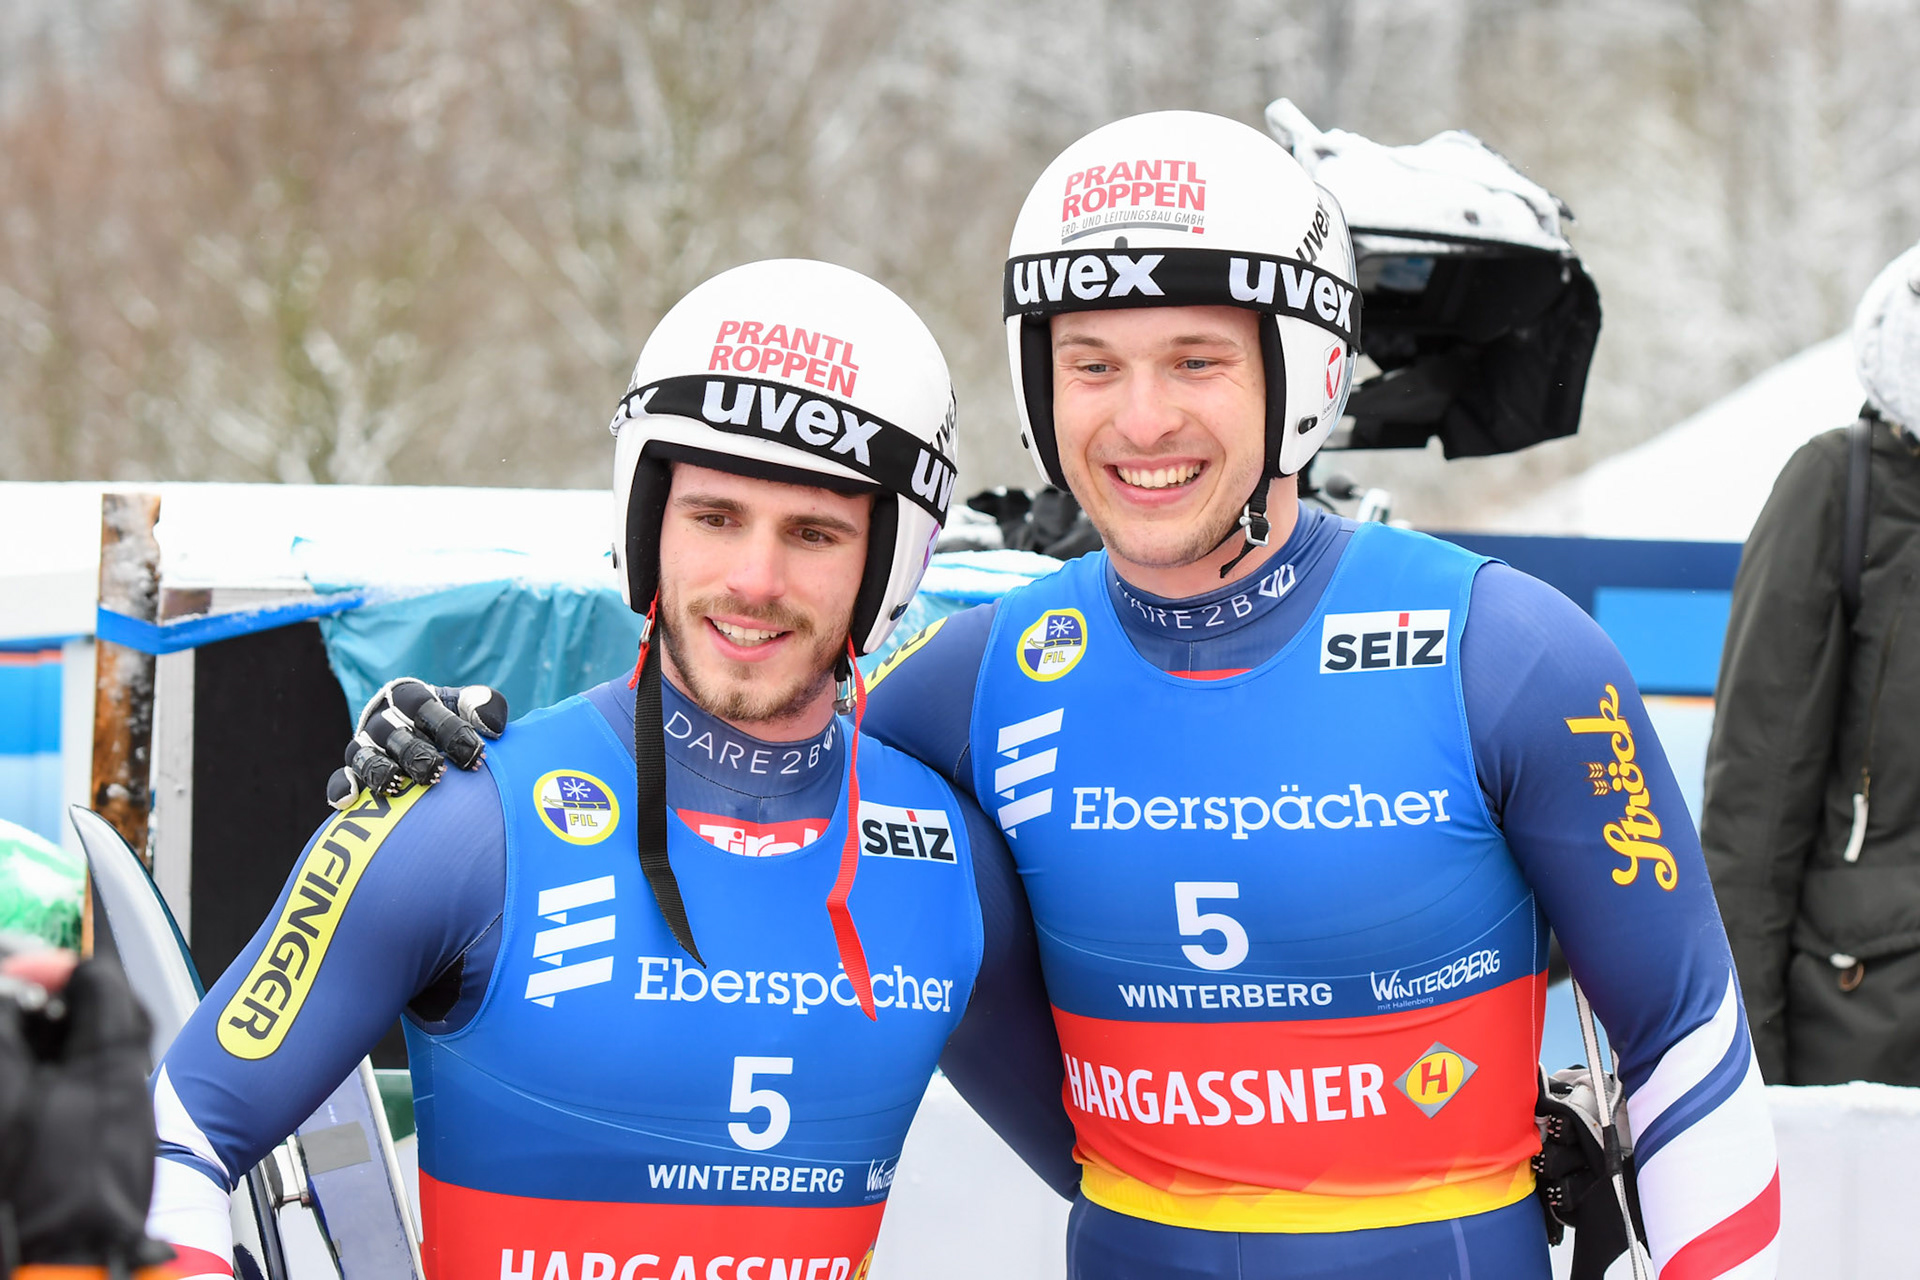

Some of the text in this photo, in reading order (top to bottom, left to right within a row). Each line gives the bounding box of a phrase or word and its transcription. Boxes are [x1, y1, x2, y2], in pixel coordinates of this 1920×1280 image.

[1062, 181, 1206, 223] ROPPEN
[1064, 159, 1206, 197] PRANTL
[1061, 209, 1205, 237] ERD- UND LEITUNGSBAU GMBH
[1013, 254, 1165, 306] uvex
[1229, 257, 1353, 333] uvex
[716, 320, 860, 371] PRANTL
[708, 345, 858, 398] ROPPEN
[701, 381, 883, 466] uvex
[1043, 651, 1066, 664] FIL
[568, 813, 598, 827] FIL
[1070, 784, 1451, 840] Eberspächer
[1174, 881, 1250, 971] 5
[1118, 981, 1334, 1009] WINTERBERG
[1377, 996, 1434, 1011] mit Hallenberg
[727, 1056, 794, 1151] 5
[1065, 1053, 1387, 1127] HARGASSNER
[648, 1164, 845, 1193] WINTERBERG
